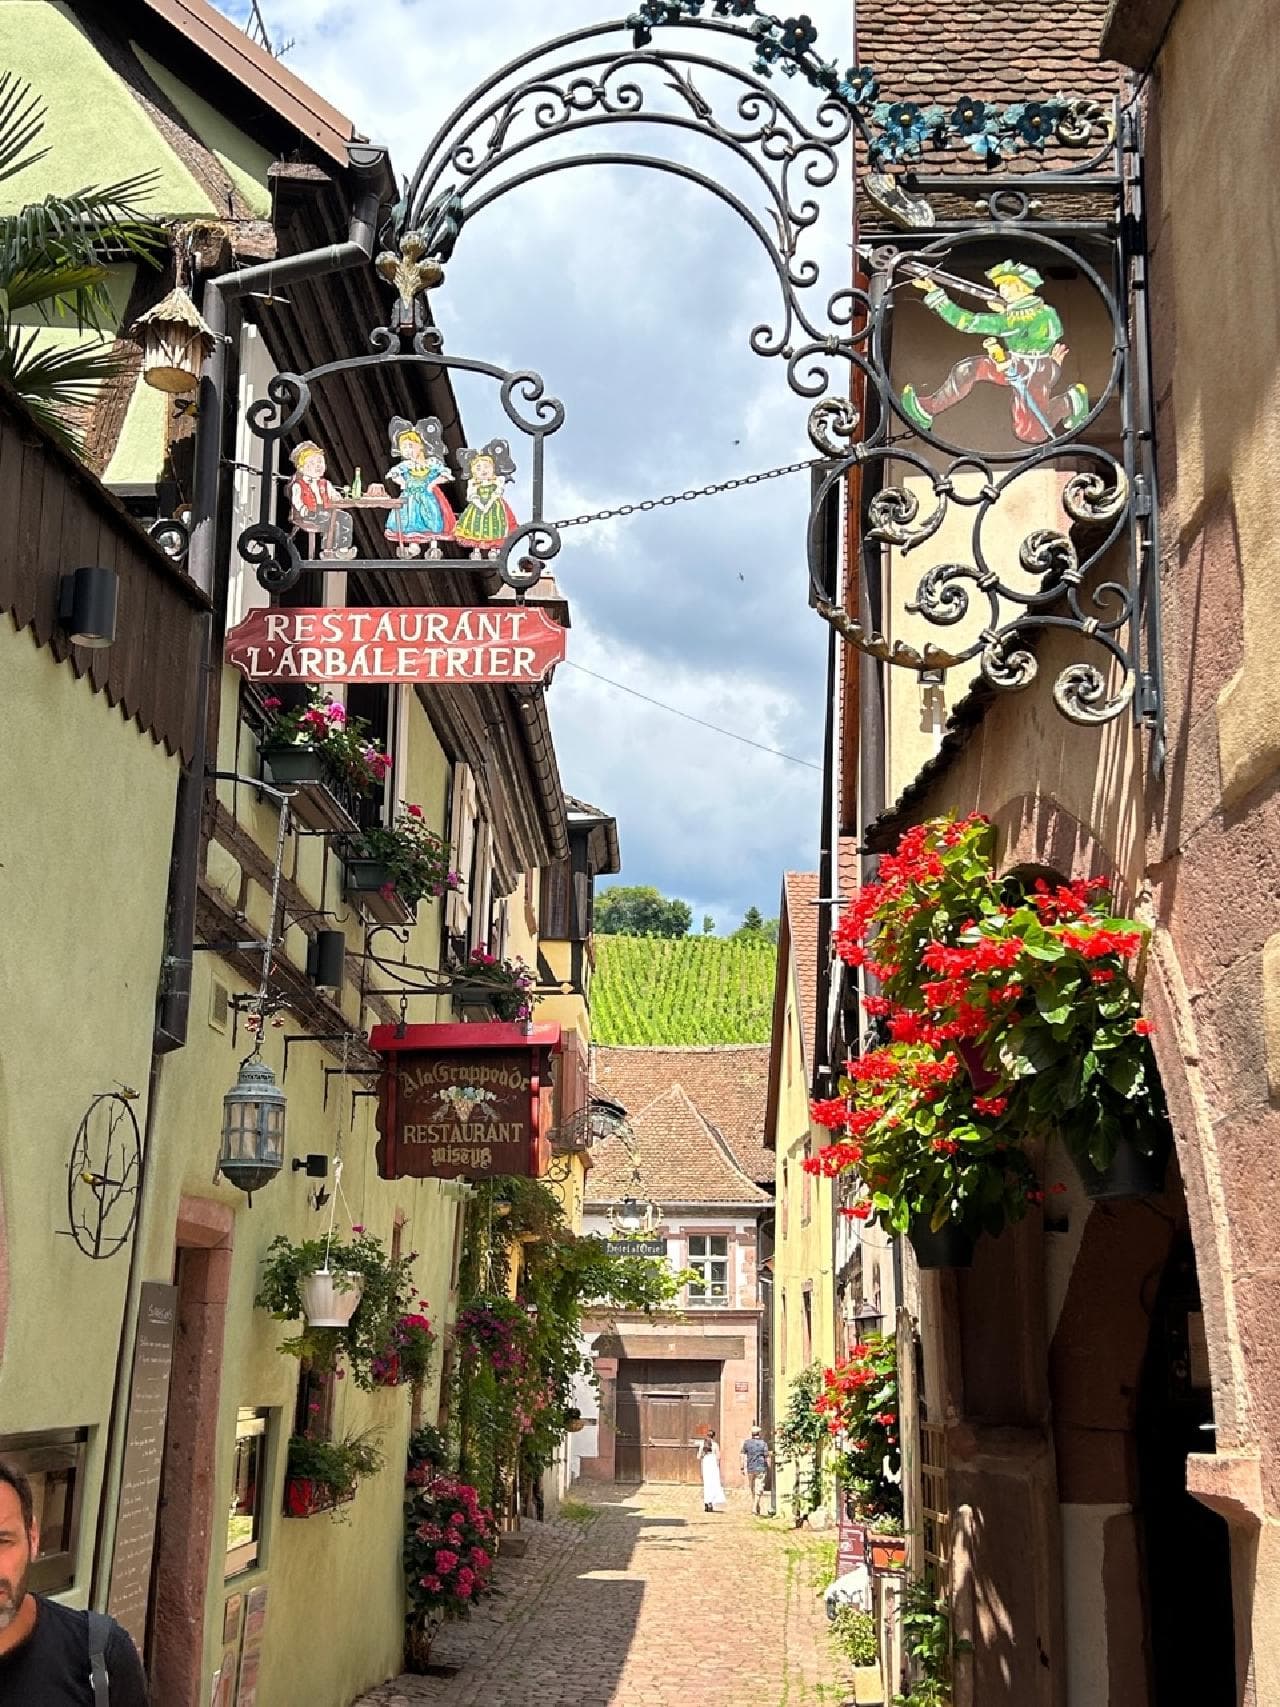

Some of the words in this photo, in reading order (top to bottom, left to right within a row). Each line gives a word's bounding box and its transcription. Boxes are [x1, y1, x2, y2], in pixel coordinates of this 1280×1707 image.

[264, 610, 527, 645] RESTAURANT
[247, 645, 543, 678] L'ARBALETRIER
[416, 1067, 434, 1087] la
[403, 1122, 524, 1145] RESTAURANT
